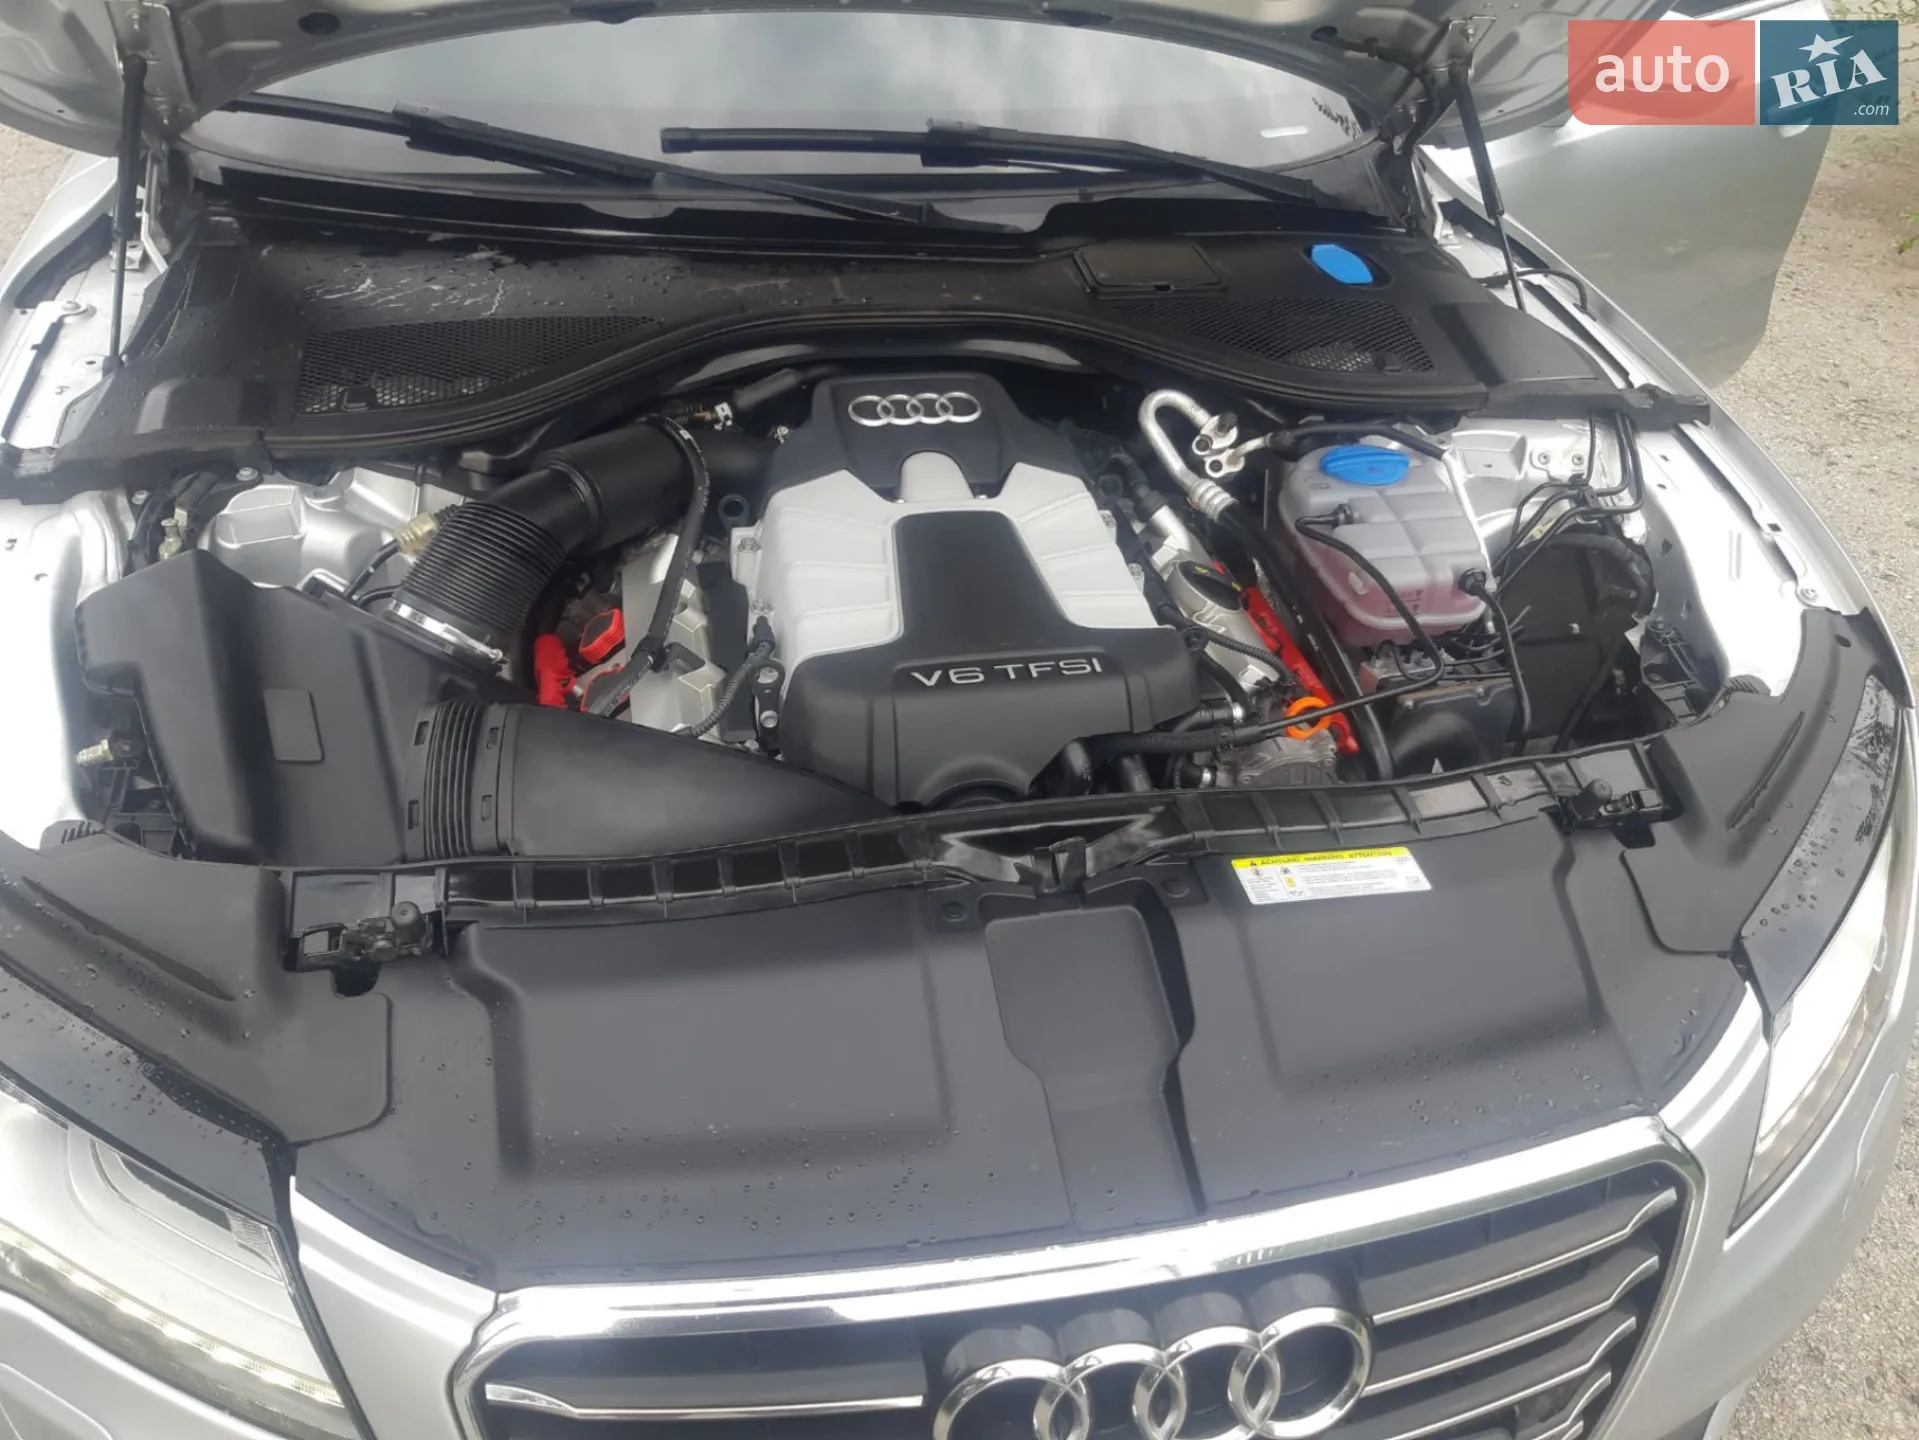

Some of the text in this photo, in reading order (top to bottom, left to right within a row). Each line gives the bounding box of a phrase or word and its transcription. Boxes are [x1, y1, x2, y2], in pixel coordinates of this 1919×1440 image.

[911, 658, 1102, 687] V6 TFSI
[1260, 856, 1301, 866] ACHTUNG
